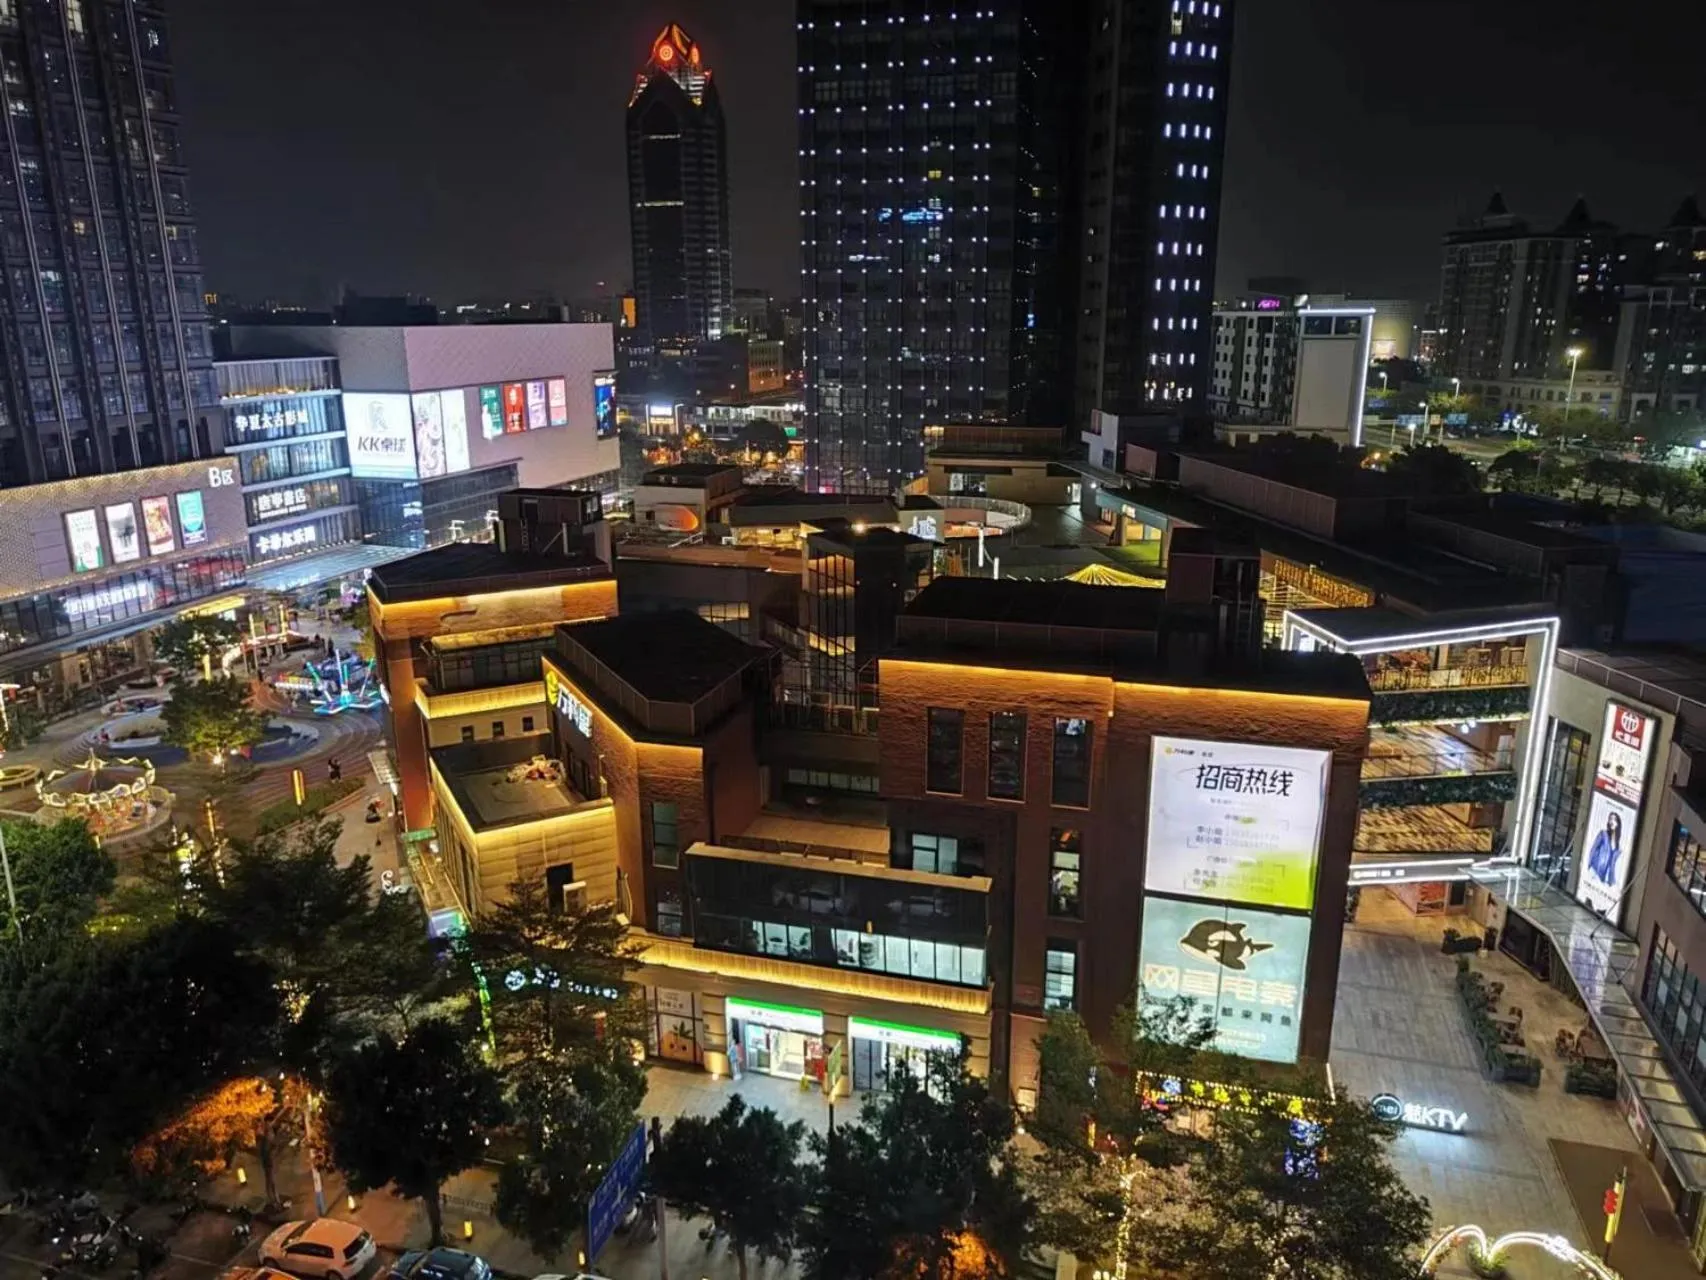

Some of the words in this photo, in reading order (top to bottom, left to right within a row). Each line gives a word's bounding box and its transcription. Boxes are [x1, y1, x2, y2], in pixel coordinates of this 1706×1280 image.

[208, 467, 234, 488] B区
[1196, 763, 1294, 797] 招商热线
